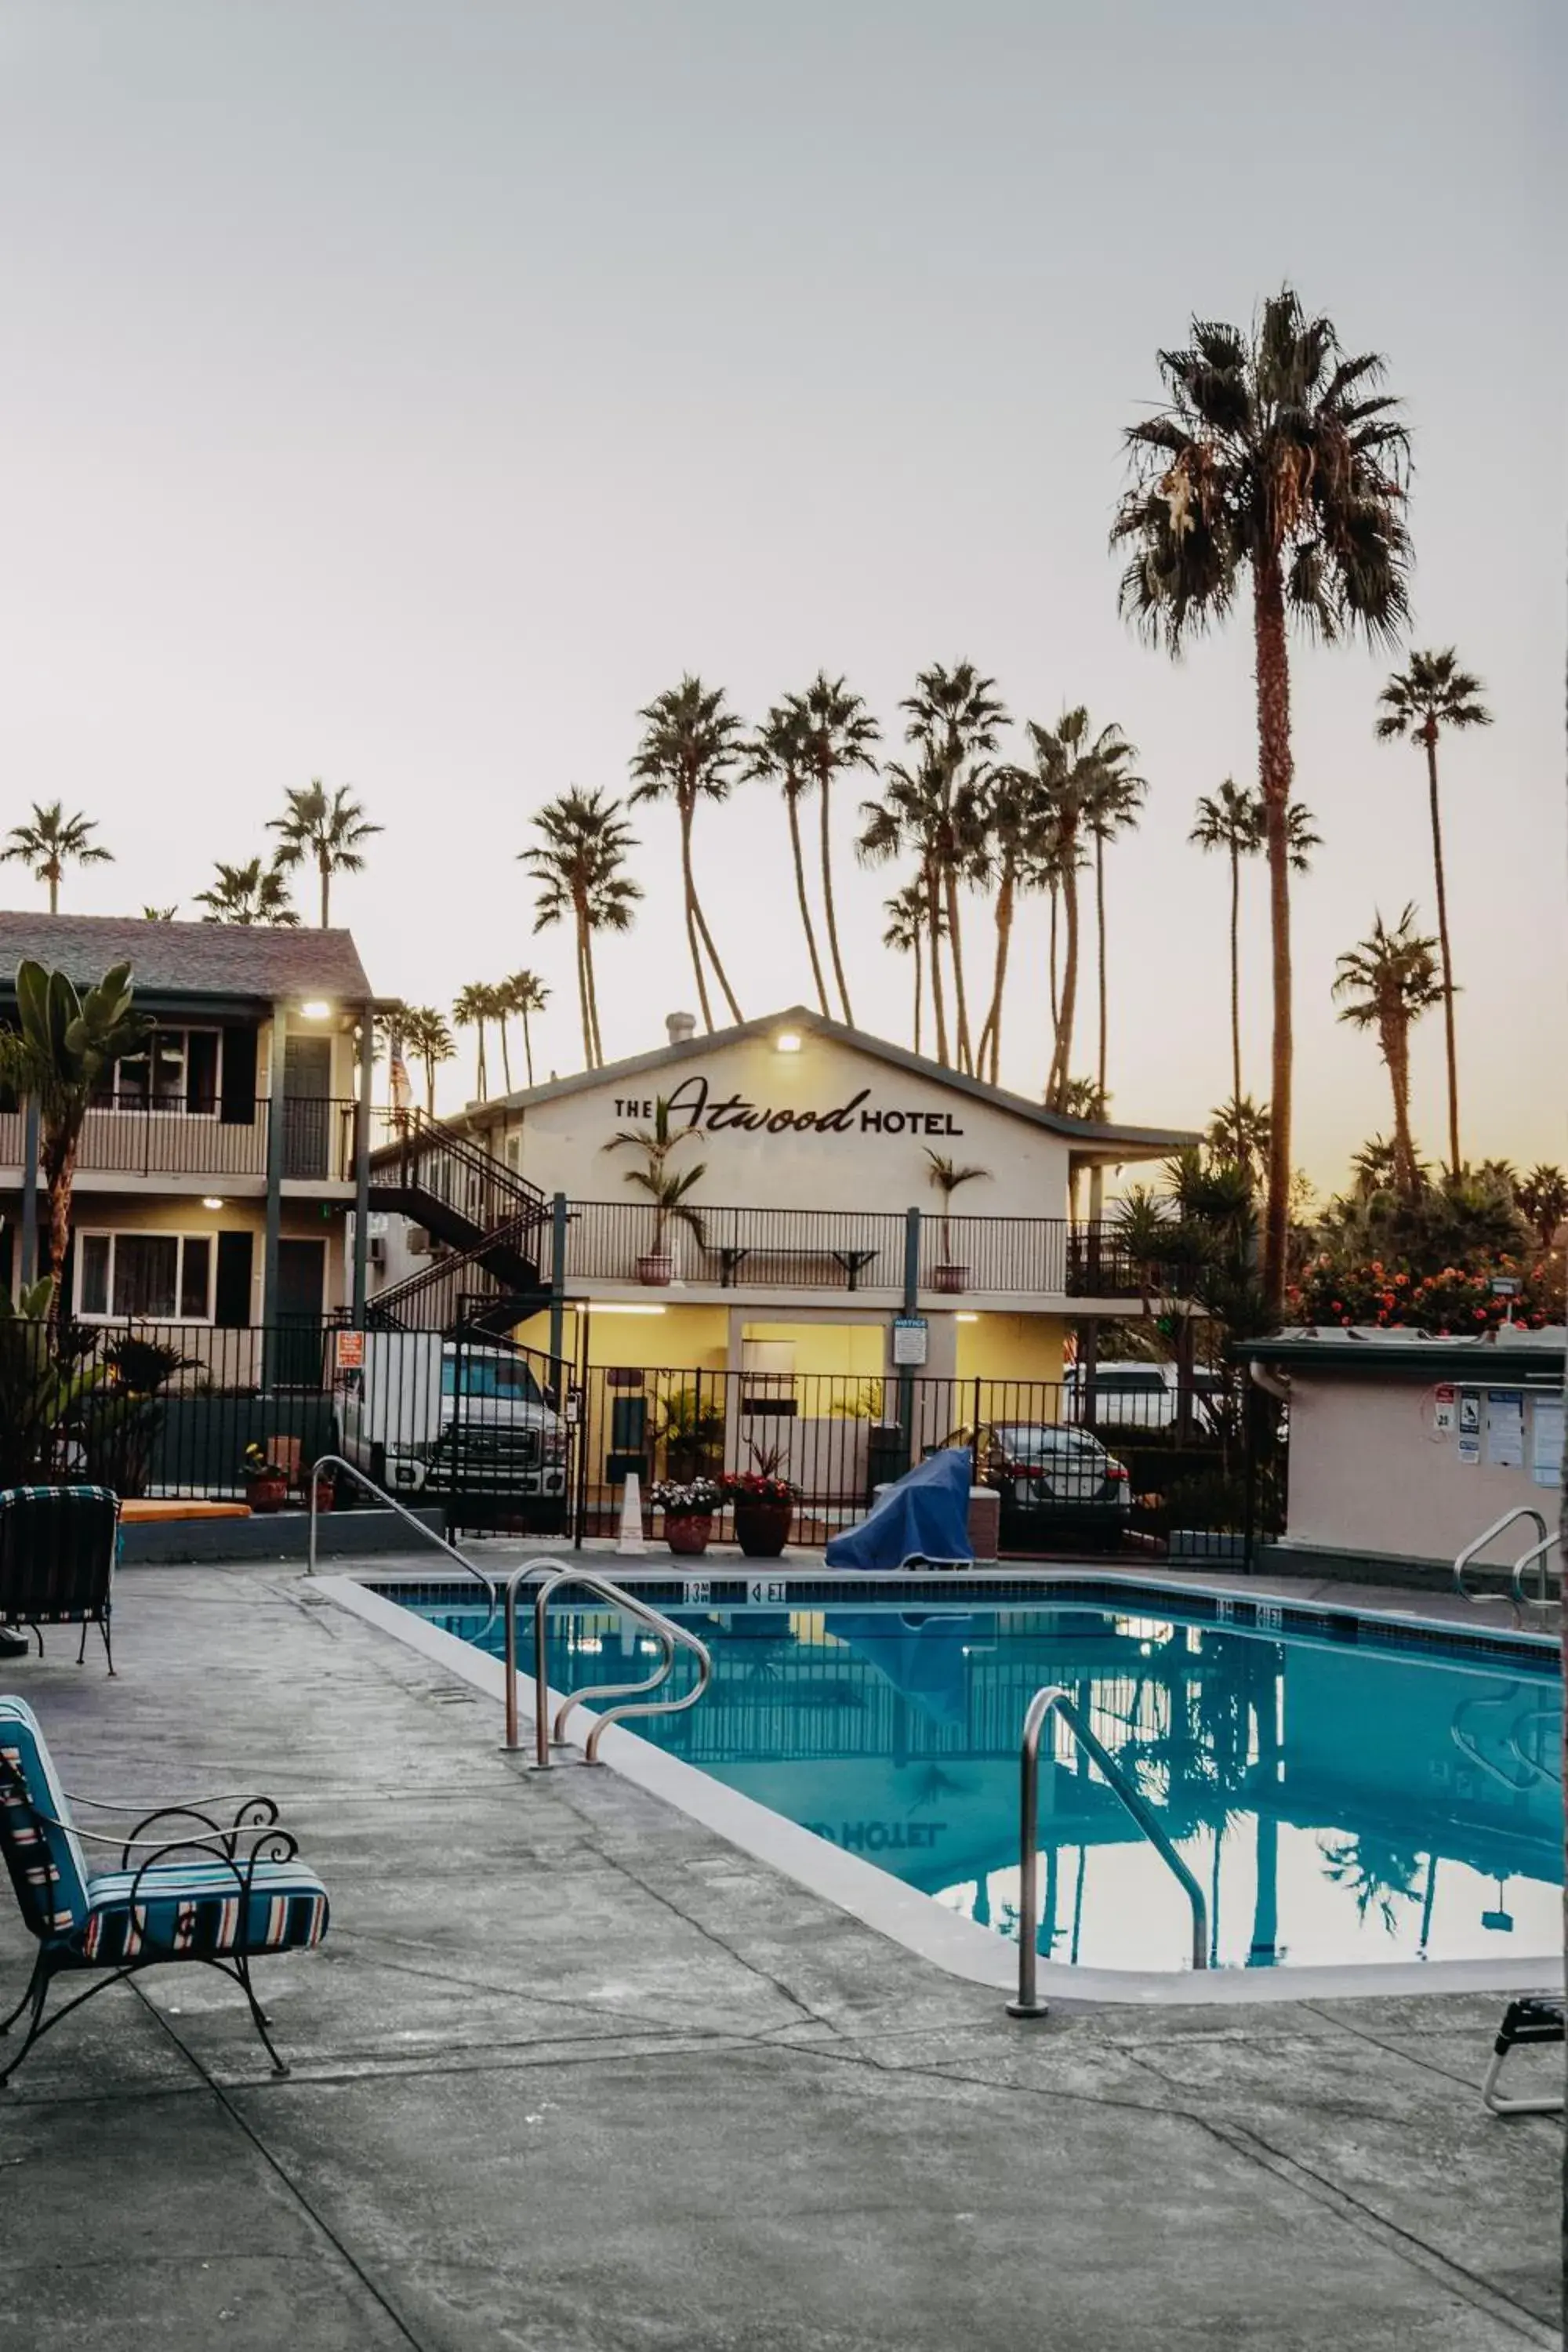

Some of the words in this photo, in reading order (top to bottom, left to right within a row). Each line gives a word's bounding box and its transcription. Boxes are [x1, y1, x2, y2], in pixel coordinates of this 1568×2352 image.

[614, 1099, 653, 1119] THE
[665, 1076, 872, 1134] Atwood
[860, 1109, 964, 1136] HOTEL
